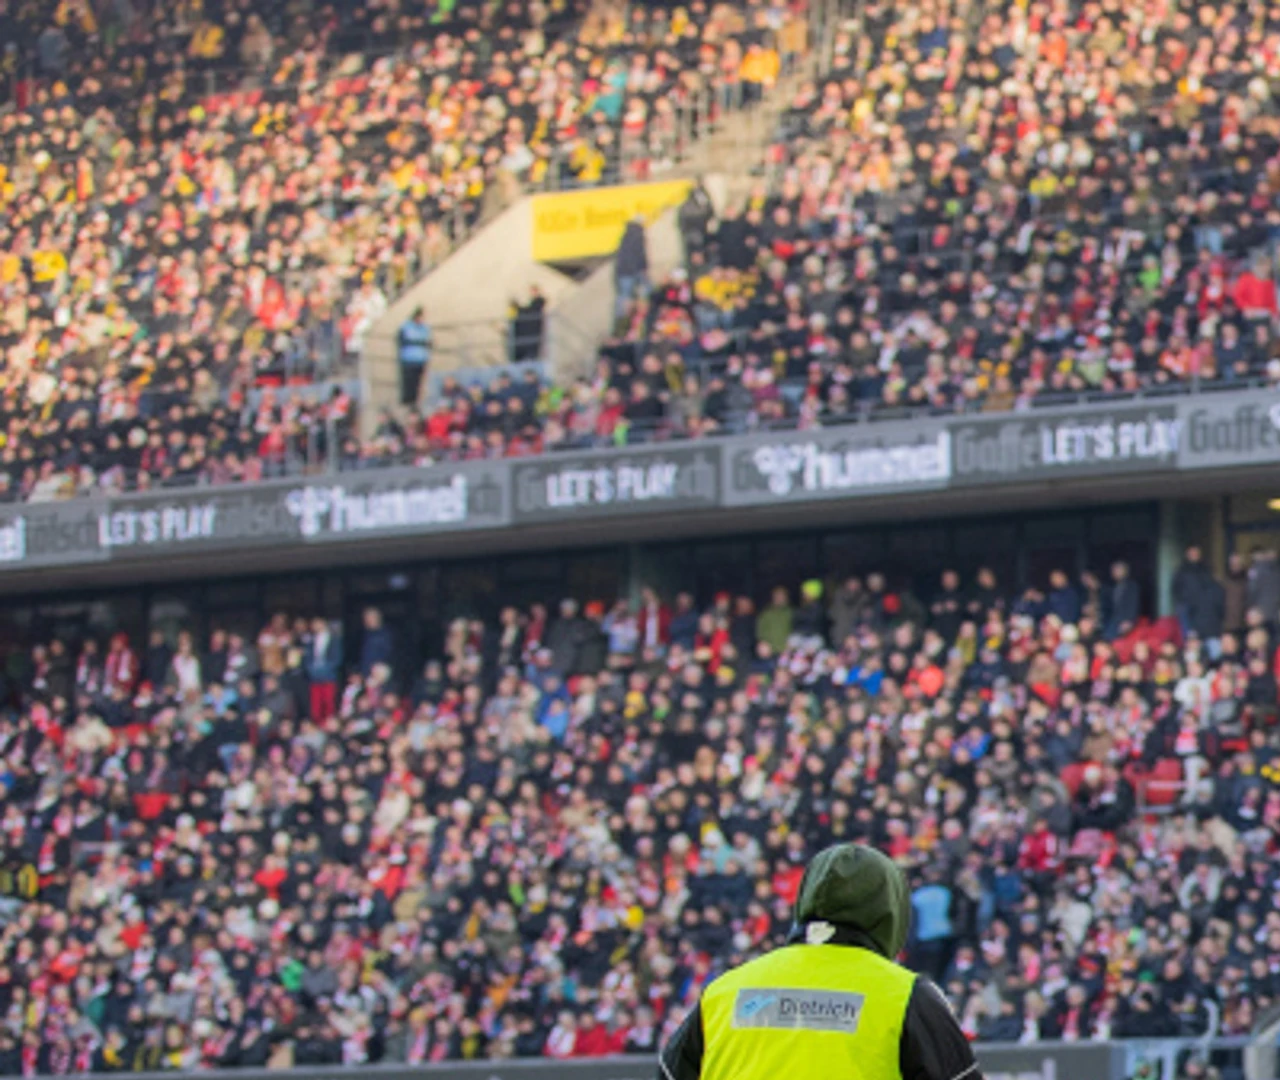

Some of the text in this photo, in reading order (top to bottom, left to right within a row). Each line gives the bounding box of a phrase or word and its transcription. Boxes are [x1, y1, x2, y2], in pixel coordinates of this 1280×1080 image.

[805, 429, 950, 490] hummel
[1042, 417, 1181, 466] LET'S PLAY
[330, 475, 467, 531] hummel
[618, 463, 677, 501] PLAY
